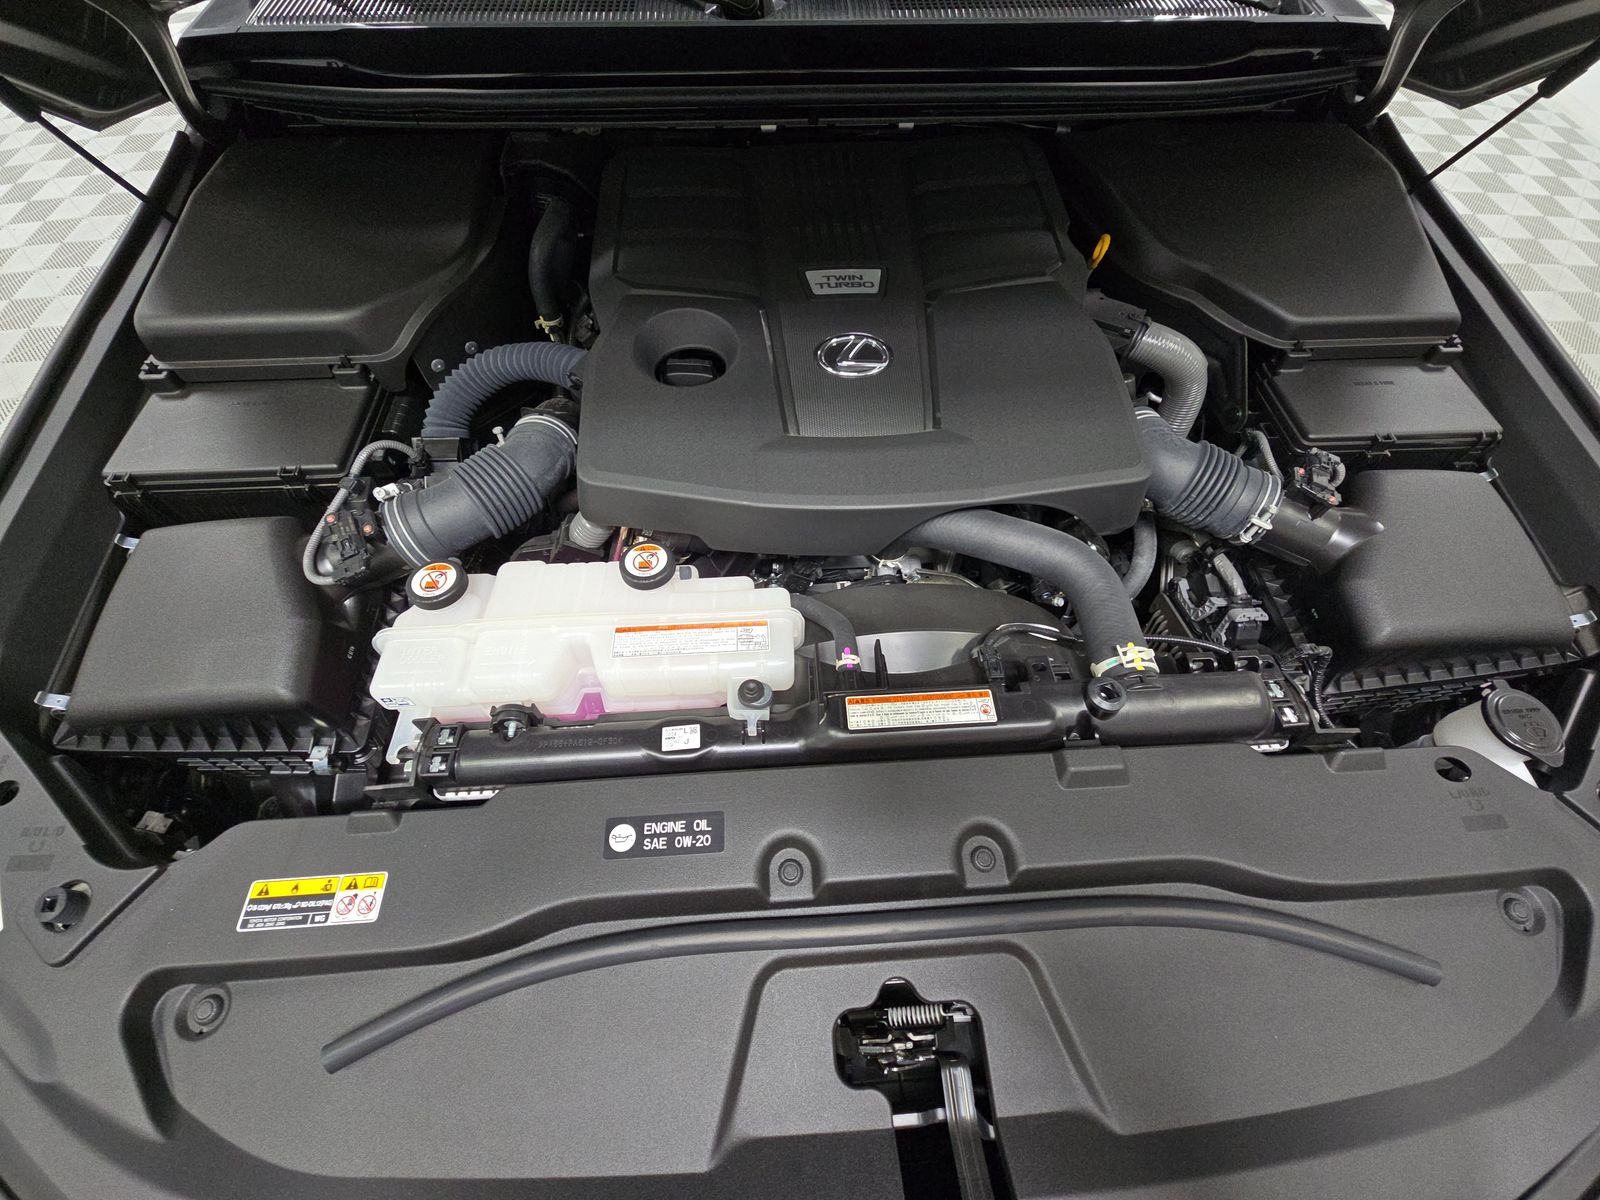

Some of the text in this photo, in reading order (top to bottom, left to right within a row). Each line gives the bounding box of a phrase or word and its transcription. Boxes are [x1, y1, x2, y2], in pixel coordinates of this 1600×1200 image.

[814, 281, 875, 289] TURBO
[643, 819, 712, 834] ENGINE OIL
[643, 834, 712, 850] SAE 0W-20
